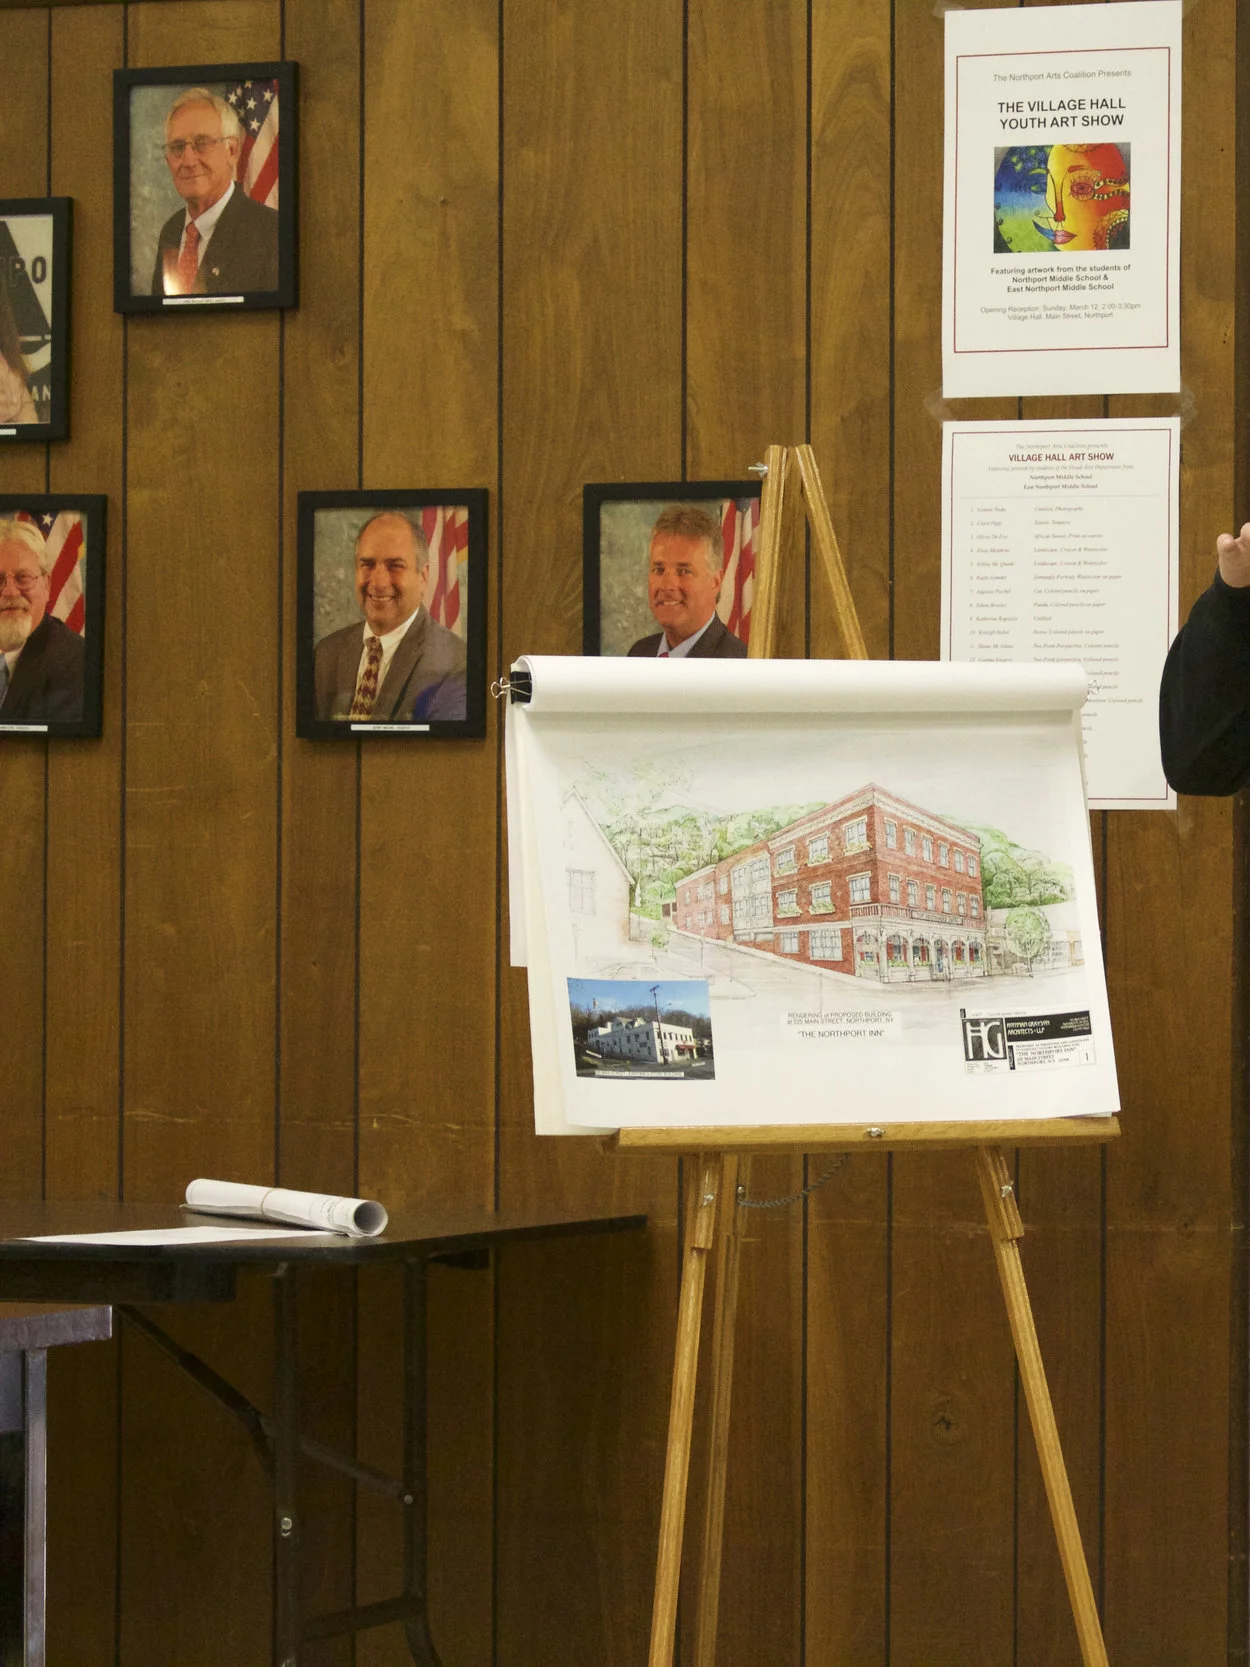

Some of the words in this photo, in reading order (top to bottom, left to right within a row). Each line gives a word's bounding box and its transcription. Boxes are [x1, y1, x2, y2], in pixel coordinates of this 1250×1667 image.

[993, 74, 1007, 82] The
[1009, 73, 1044, 82] Northport
[1046, 72, 1061, 80] Arts
[1063, 71, 1096, 79] Coalition
[1098, 69, 1132, 78] Presents
[998, 102, 1024, 113] THE
[1028, 99, 1086, 112] VILLAGE
[1090, 98, 1126, 110] HALL
[1000, 117, 1047, 130] YOUTH
[1050, 116, 1078, 128] ART
[1081, 114, 1124, 127] SHOW
[990, 267, 1025, 276] Featuring
[1027, 266, 1055, 274] artwork
[1056, 265, 1074, 273] from
[1089, 264, 1121, 272] students
[1012, 276, 1048, 284] Northport
[1075, 274, 1101, 282] School
[1025, 285, 1060, 293] Northport
[1088, 283, 1114, 291] School
[980, 306, 1007, 315] Opening
[1069, 303, 1089, 311] March
[1007, 314, 1029, 322] Village
[1084, 311, 1114, 320] Northport
[1009, 453, 1043, 462] VILLAGE
[1045, 453, 1067, 461] HALL
[1069, 452, 1086, 461] ART
[1088, 452, 1115, 461] SHOW
[818, 1029, 866, 1038] NORTHPORT
